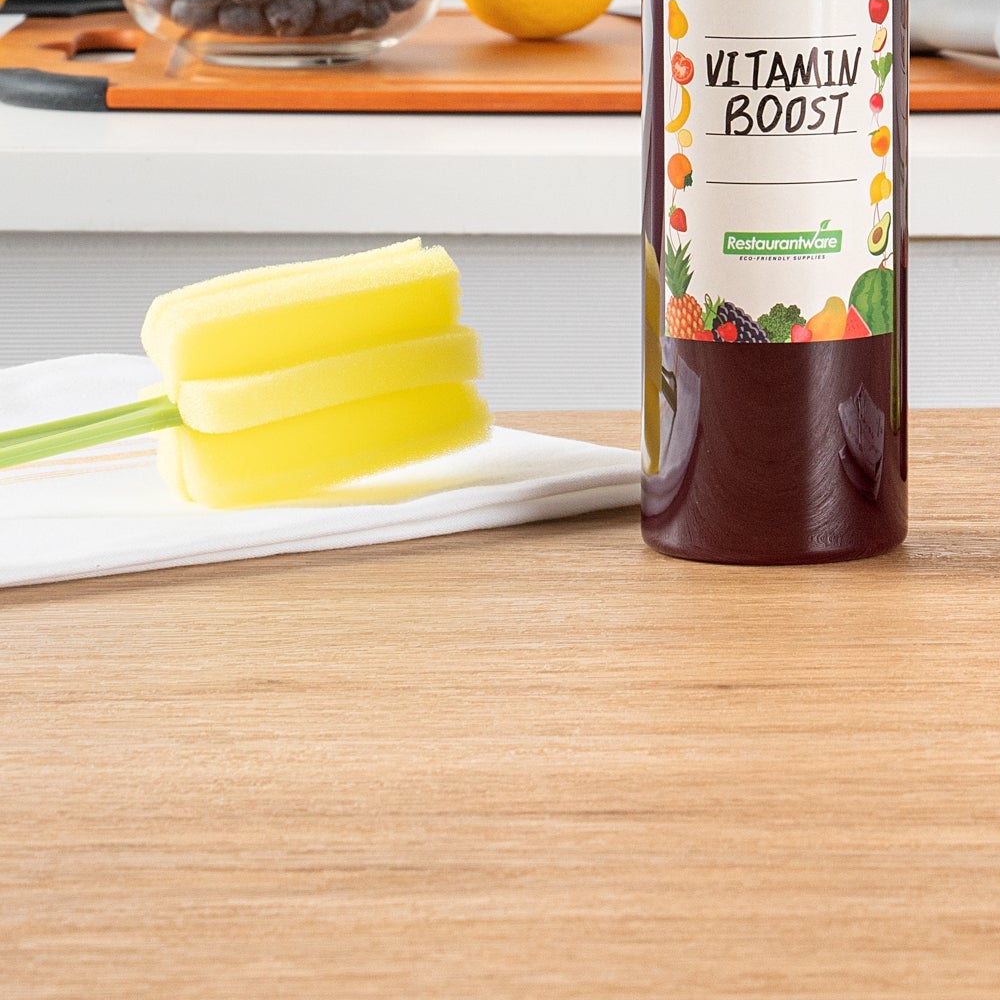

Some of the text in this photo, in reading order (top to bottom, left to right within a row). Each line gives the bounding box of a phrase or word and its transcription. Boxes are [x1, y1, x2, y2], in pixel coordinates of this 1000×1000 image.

[706, 46, 862, 91] VITAMIN
[724, 91, 849, 135] BOOST
[726, 231, 838, 251] Restaurantware
